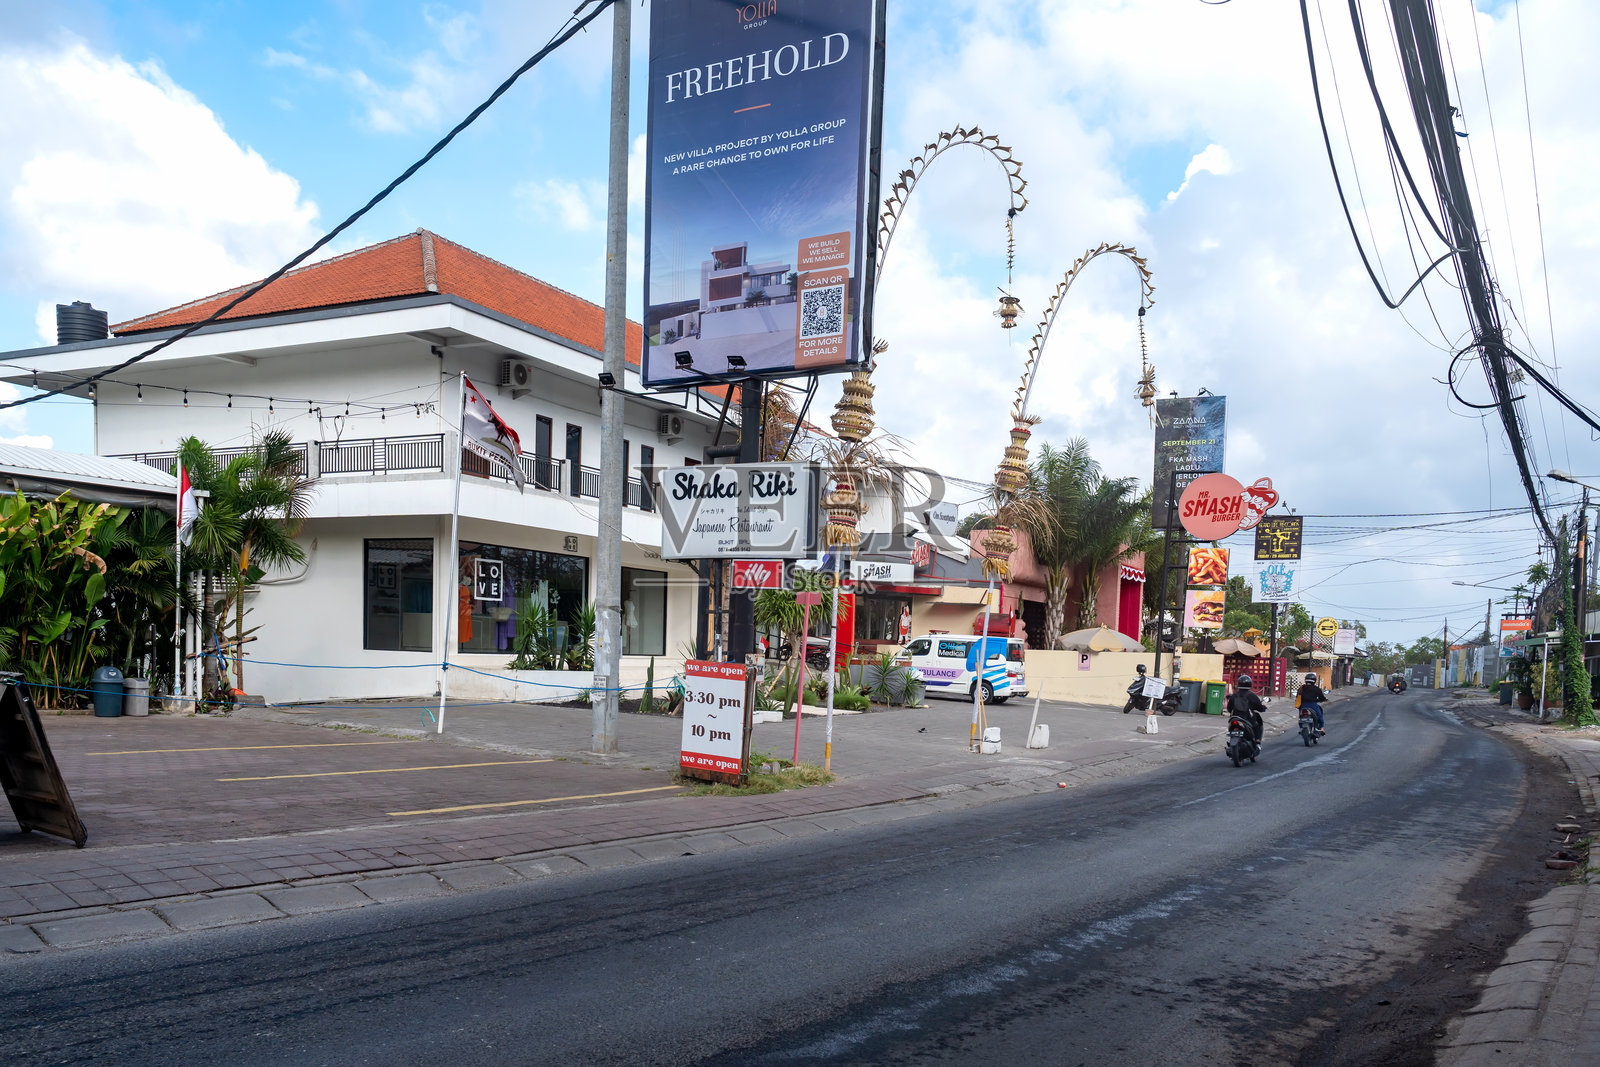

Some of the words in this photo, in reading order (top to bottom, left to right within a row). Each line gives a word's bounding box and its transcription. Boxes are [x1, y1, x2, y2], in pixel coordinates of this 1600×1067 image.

[736, 0, 777, 24] YOLLA
[743, 19, 768, 30] GROUP
[665, 32, 850, 104] FREEHOLD
[664, 151, 685, 164] NEW
[687, 146, 714, 159] VILLA
[715, 137, 760, 153] PROJECT
[761, 133, 774, 144] BY
[775, 126, 808, 141] YOLLA
[810, 118, 847, 133] GROUP
[672, 167, 680, 176] A
[680, 162, 705, 174] RARE
[706, 153, 747, 168] CHANCE
[749, 150, 762, 160] TO
[763, 144, 789, 157] OWN
[790, 141, 811, 152] FOR
[813, 135, 835, 147] LIFE
[820, 239, 841, 248] BUILD
[821, 246, 838, 255] SELL
[814, 252, 845, 263] MANAGE
[804, 277, 829, 288] SCAN
[830, 275, 843, 285] QR
[799, 340, 817, 349] FOR
[817, 336, 844, 346] MORE
[803, 346, 838, 357] DETAILS
[1173, 416, 1207, 425] ZAMNA
[468, 441, 487, 456] BUKIT
[1162, 439, 1207, 447] SEPTEMBER
[672, 472, 742, 501] Shaka
[748, 470, 797, 498] Riki
[1198, 491, 1210, 499] MR.
[1183, 496, 1242, 518] SMASH
[1211, 513, 1241, 523] BURGER
[692, 518, 726, 539] Japanese
[728, 517, 774, 533] Restaurant
[743, 562, 771, 586] illy
[863, 564, 892, 578] SMASH
[1267, 563, 1286, 575] OLÉ
[938, 649, 966, 657] Medical
[1081, 655, 1089, 663] P
[687, 663, 700, 671] we
[702, 665, 718, 673] are
[720, 666, 743, 676] open
[918, 668, 957, 678] BULANCE
[685, 690, 715, 705] 3:30
[718, 696, 741, 709] pm
[691, 724, 705, 737] 10
[709, 729, 732, 741] pm
[682, 755, 695, 763] we
[697, 756, 714, 765] are
[715, 759, 739, 770] open
